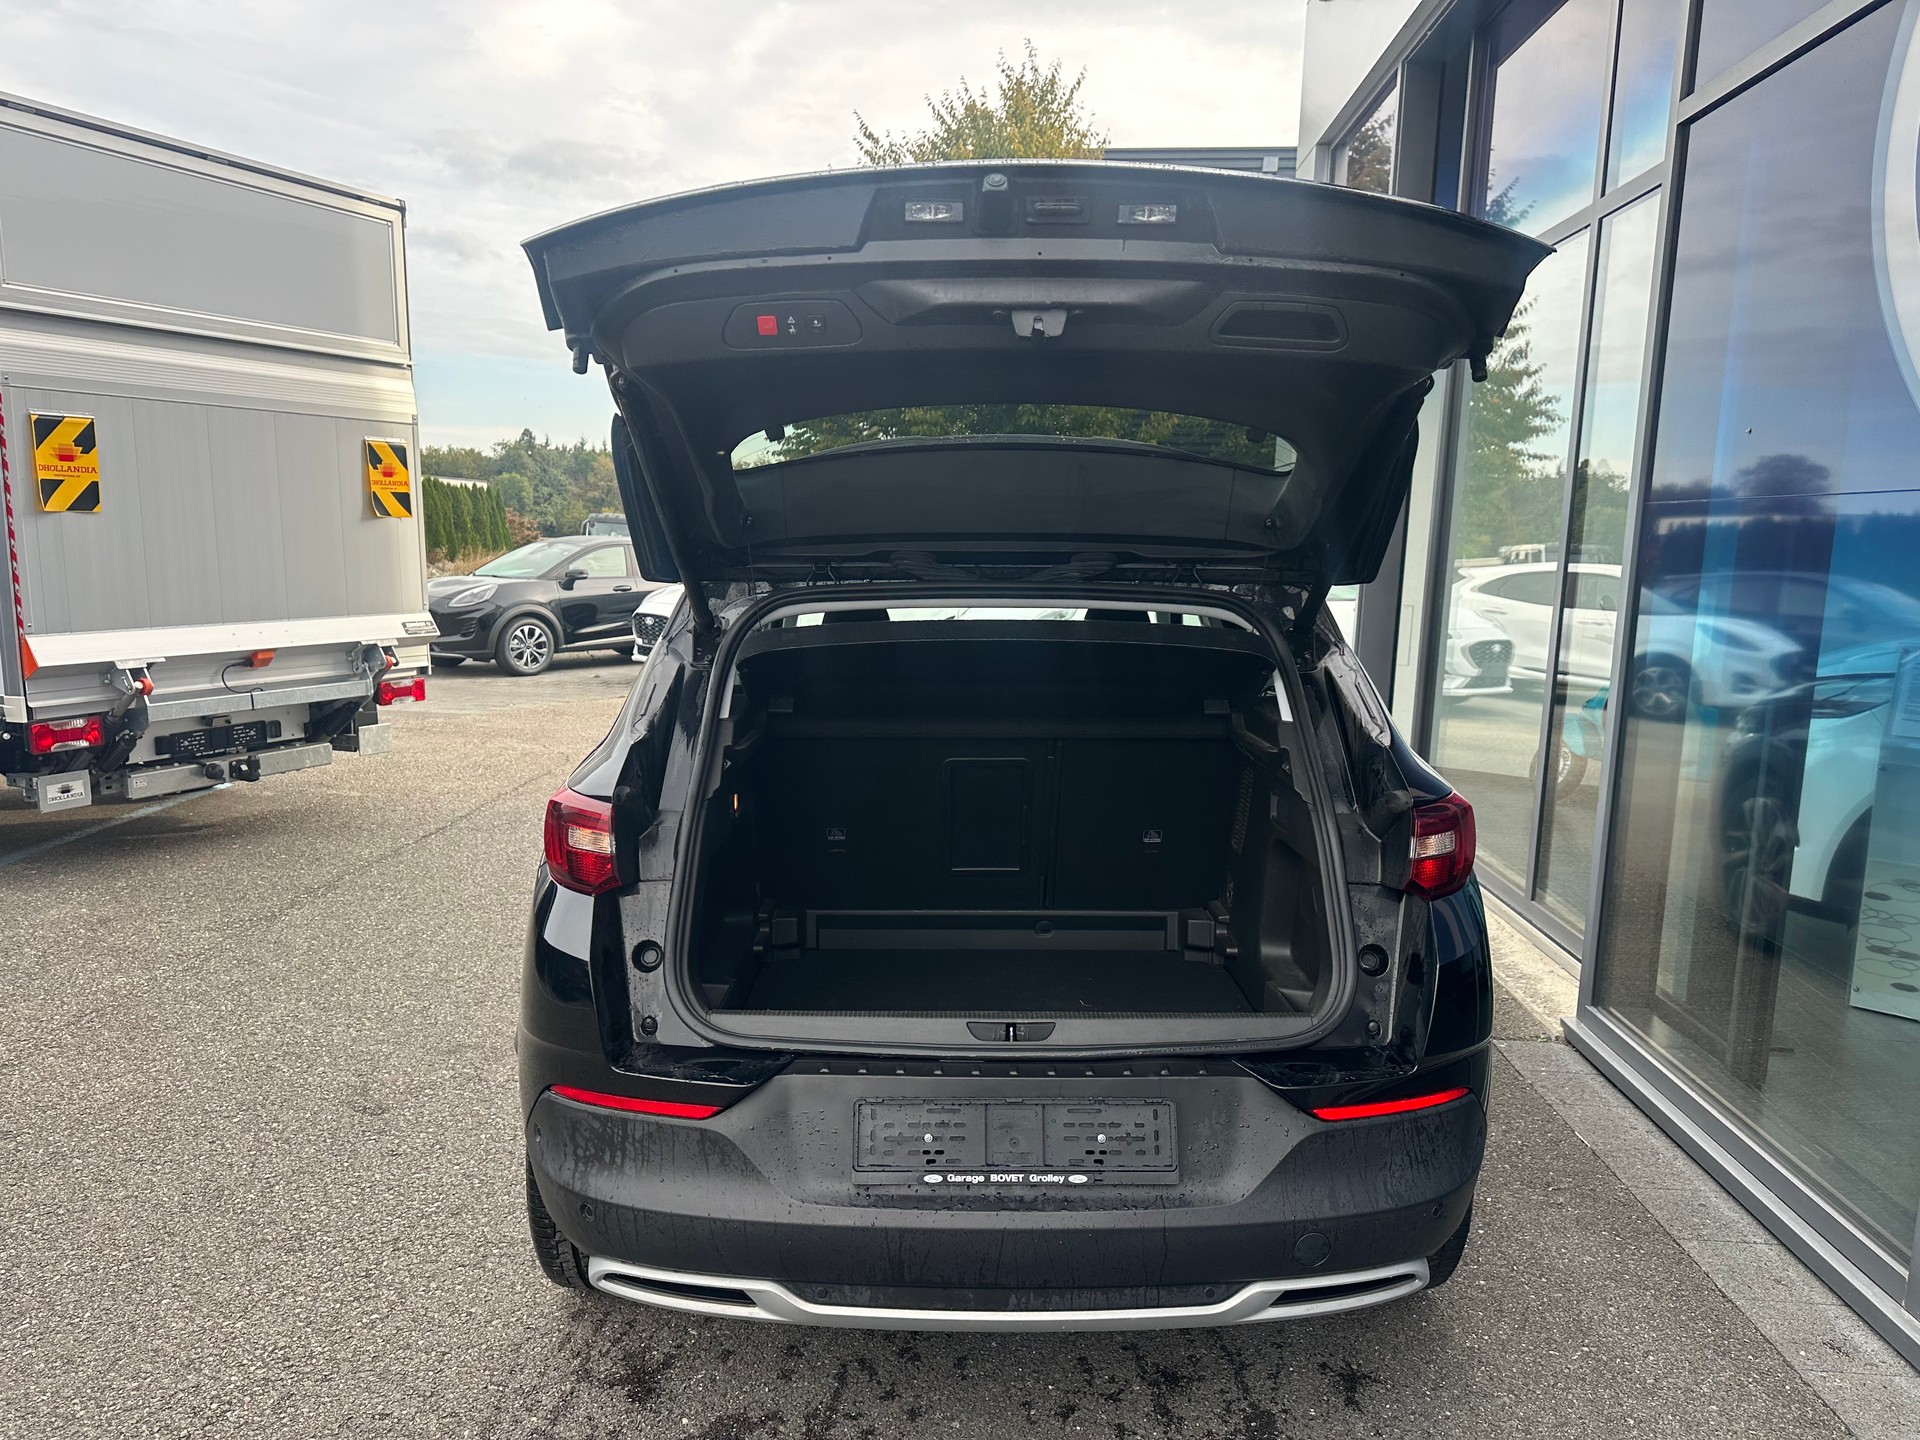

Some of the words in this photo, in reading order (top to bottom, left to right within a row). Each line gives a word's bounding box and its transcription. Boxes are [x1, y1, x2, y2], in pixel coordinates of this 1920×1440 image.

[38, 464, 98, 474] DHOLLANDIA
[48, 791, 84, 803] DHOLLANDIA
[946, 1173, 985, 1184] Garage
[990, 1173, 1025, 1183] BOVET
[1029, 1174, 1065, 1184] Grolley
